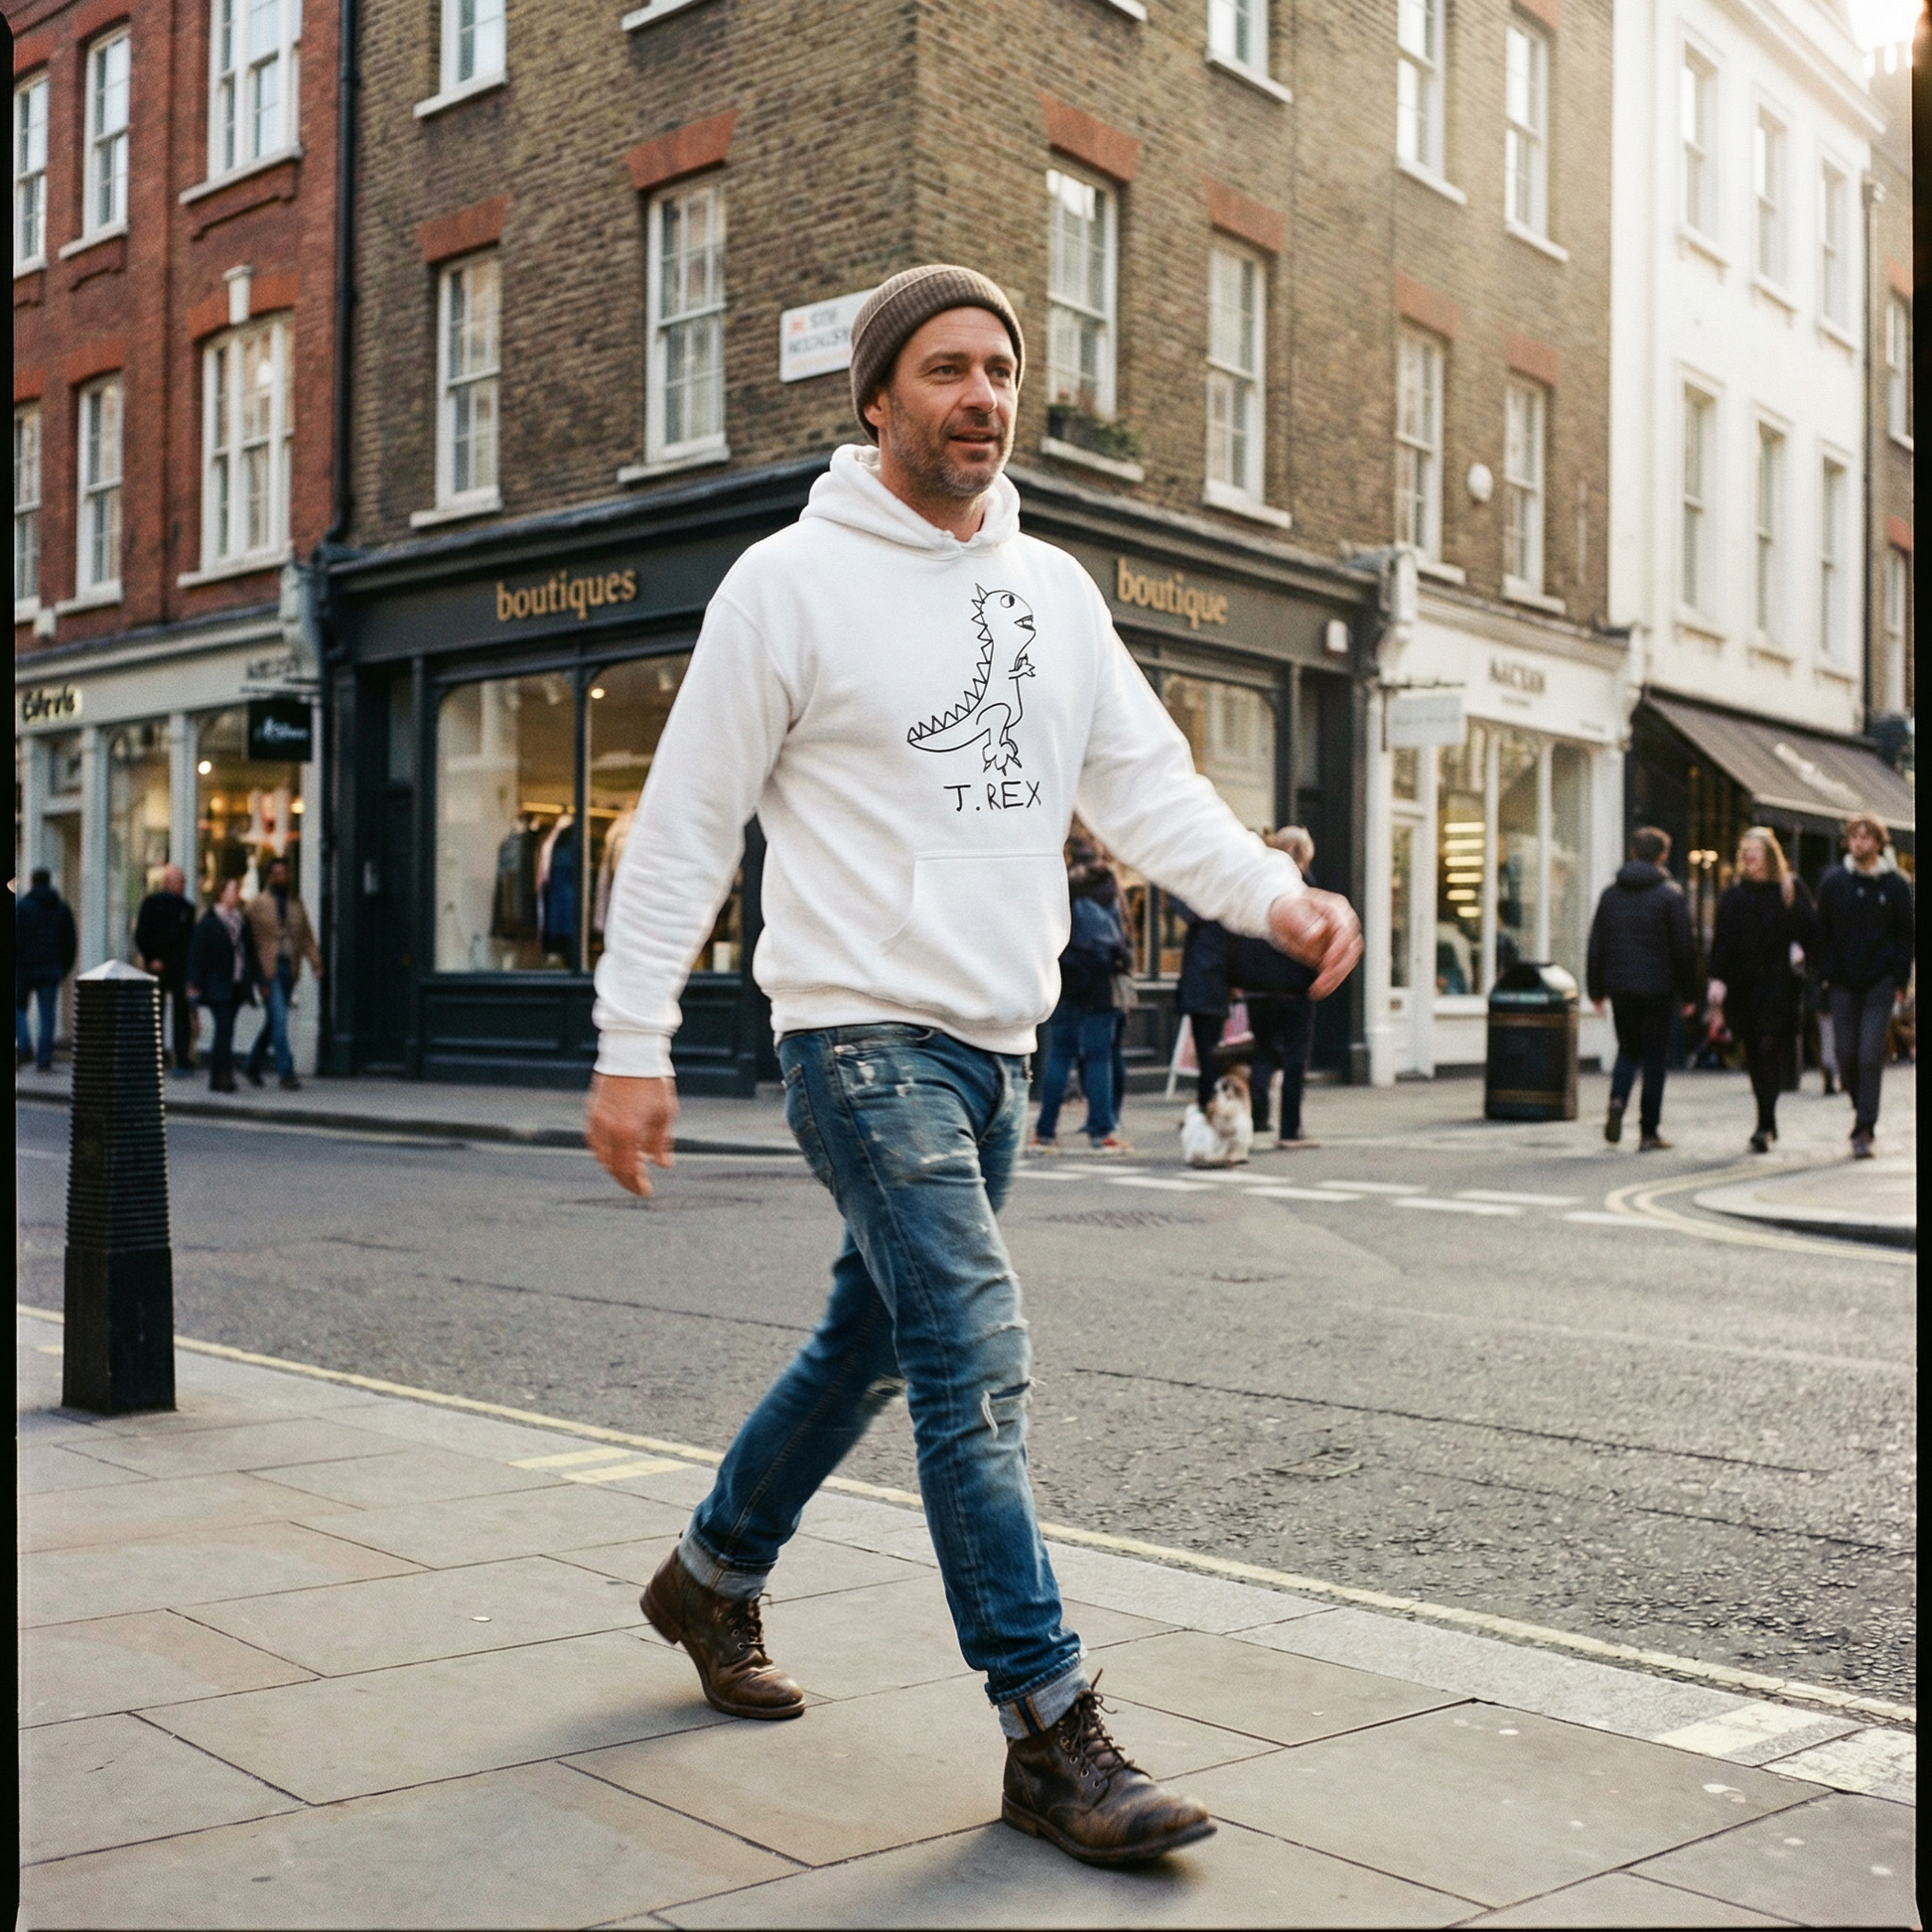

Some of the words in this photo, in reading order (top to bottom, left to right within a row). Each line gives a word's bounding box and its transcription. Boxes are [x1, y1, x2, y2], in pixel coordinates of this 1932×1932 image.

[496, 568, 637, 622] boutiques
[1117, 556, 1228, 630] boutique
[943, 779, 1041, 811] T.REX
